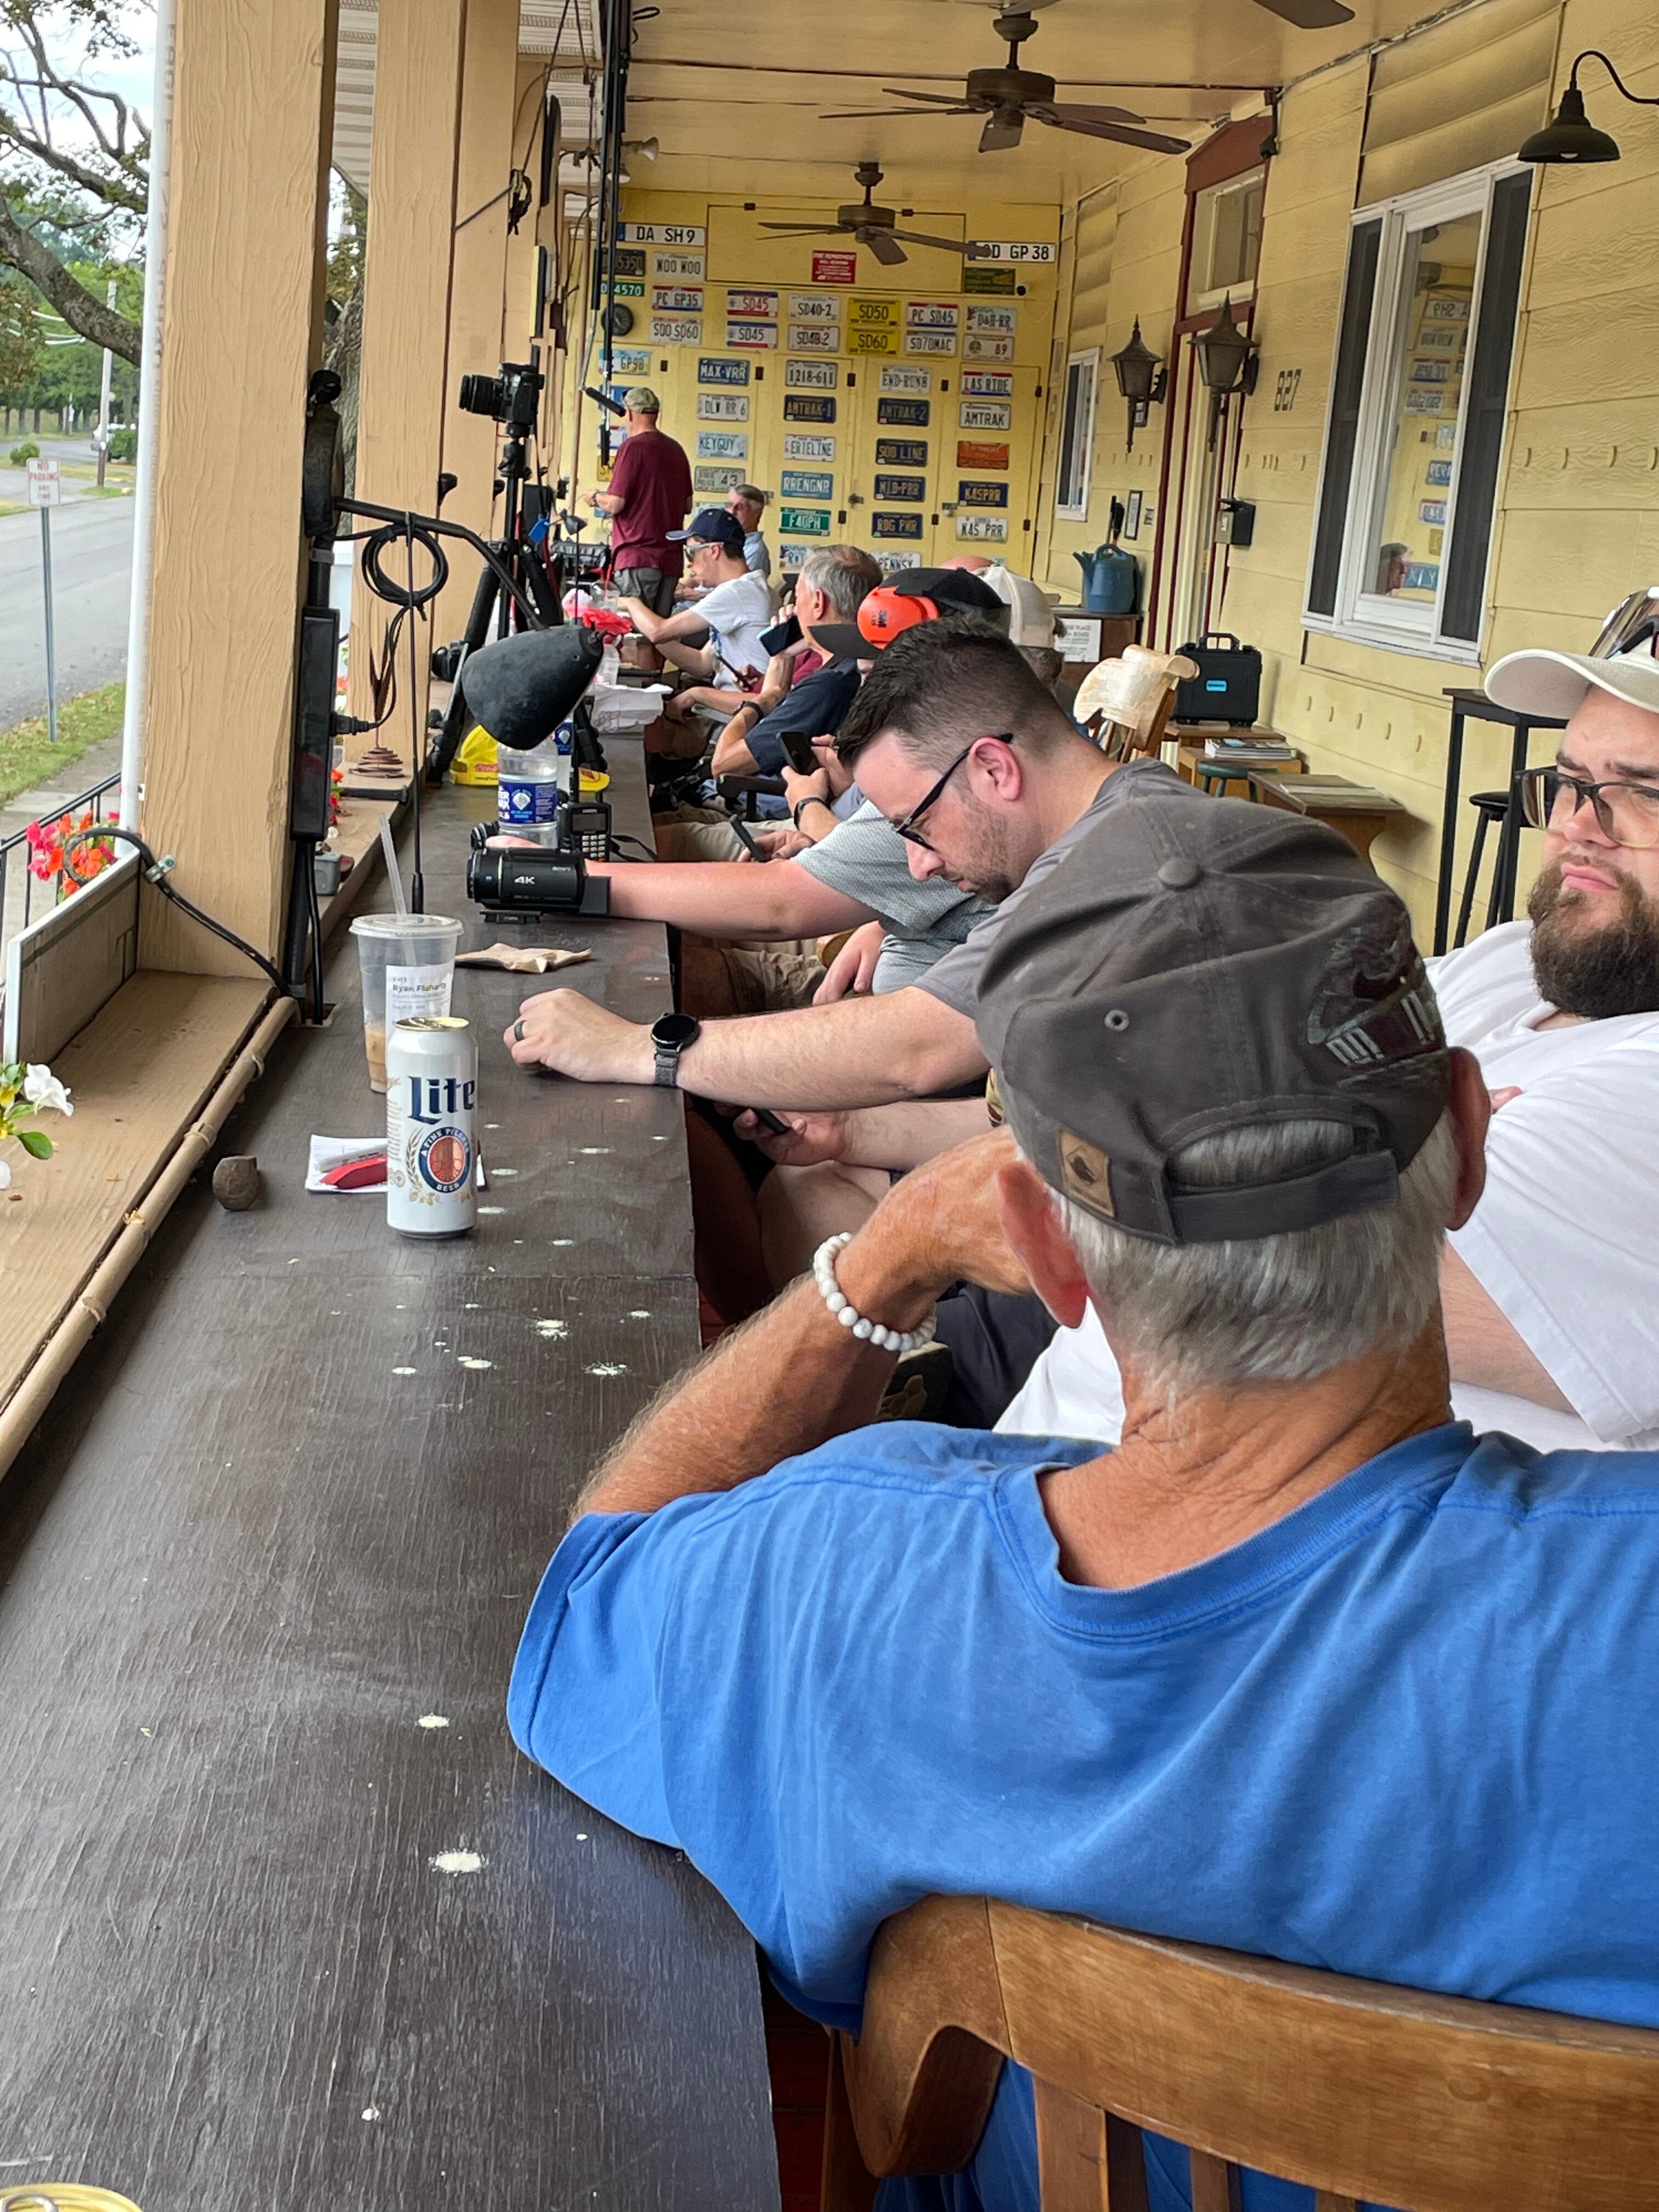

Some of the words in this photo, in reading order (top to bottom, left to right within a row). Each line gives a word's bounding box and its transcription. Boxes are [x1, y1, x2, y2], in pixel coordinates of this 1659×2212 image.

[637, 226, 654, 241] DA
[657, 292, 668, 305] PC
[859, 304, 889, 319] SD50
[912, 309, 924, 321] PC
[738, 328, 764, 341] SD45
[858, 334, 888, 349] SD60
[995, 343, 1007, 356] 89
[1274, 369, 1302, 411] 827
[741, 403, 746, 415] 6
[964, 411, 1005, 426] AMTRAK
[721, 474, 738, 487] 43
[985, 523, 1003, 537] PRR
[514, 876, 535, 884] 4K
[407, 1075, 476, 1125] Lite
